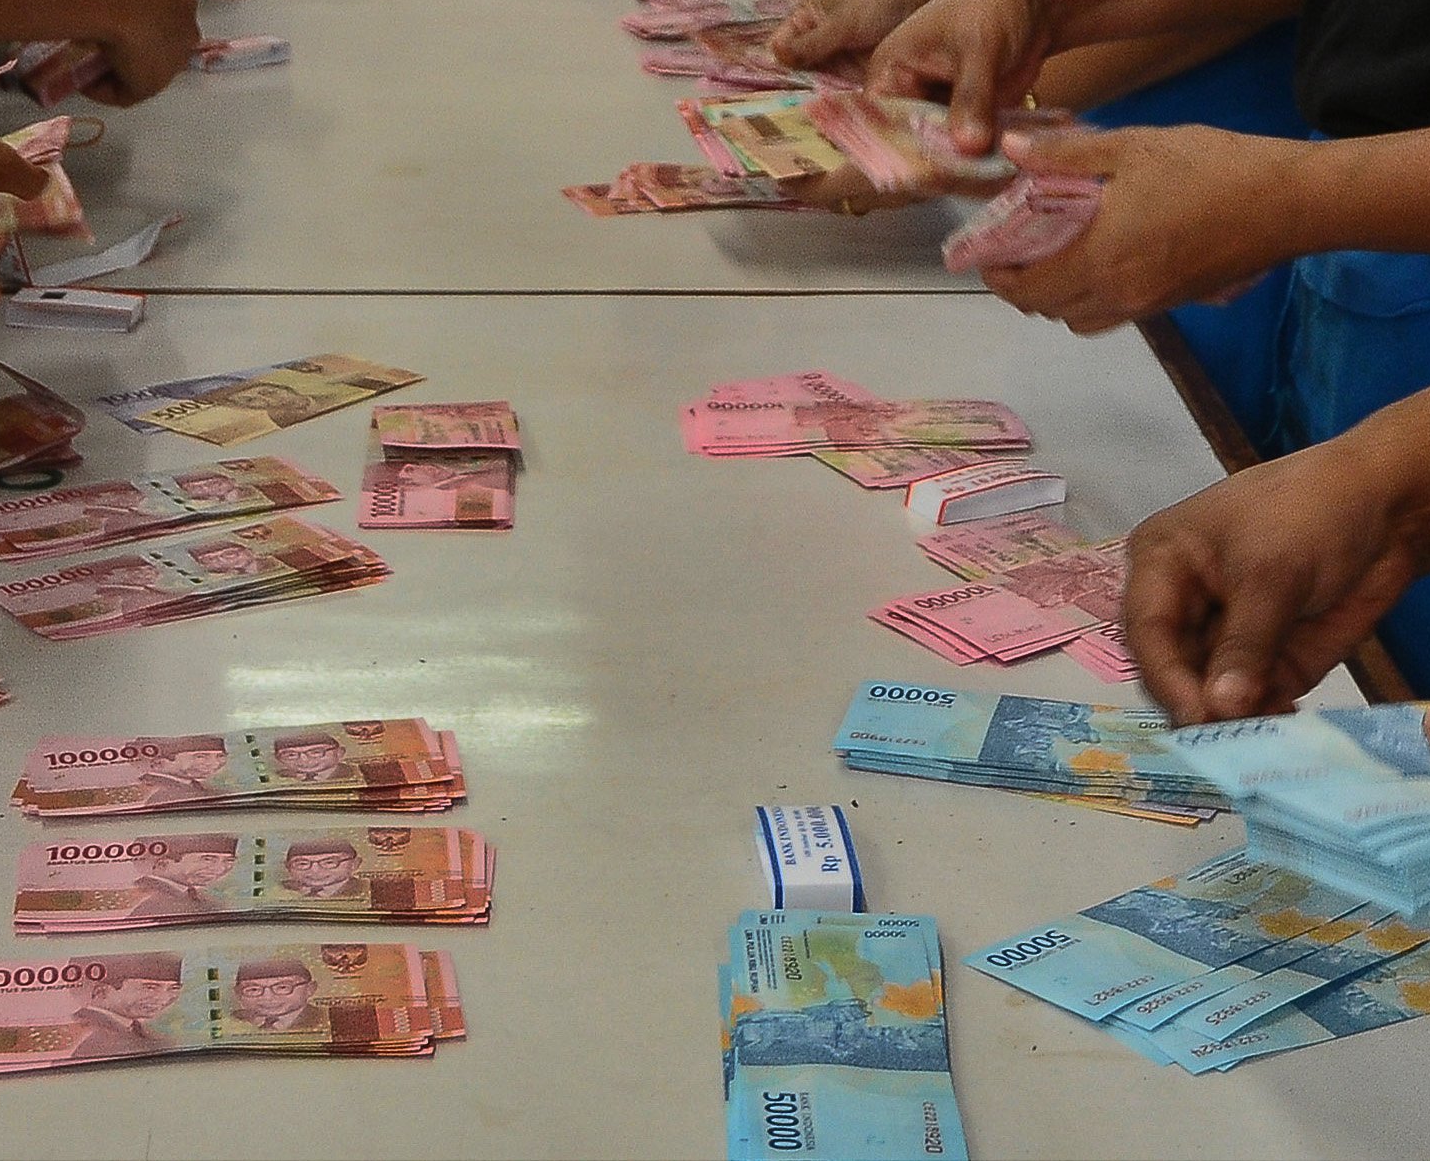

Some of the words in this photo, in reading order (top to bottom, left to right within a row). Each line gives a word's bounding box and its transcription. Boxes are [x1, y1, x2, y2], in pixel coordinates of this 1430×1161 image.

[870, 685, 957, 706] 50000
[44, 744, 160, 766] 100000
[46, 841, 168, 861] 100000
[821, 855, 842, 872] Rp
[987, 929, 1071, 968] 50000
[763, 1091, 803, 1151] 50000
